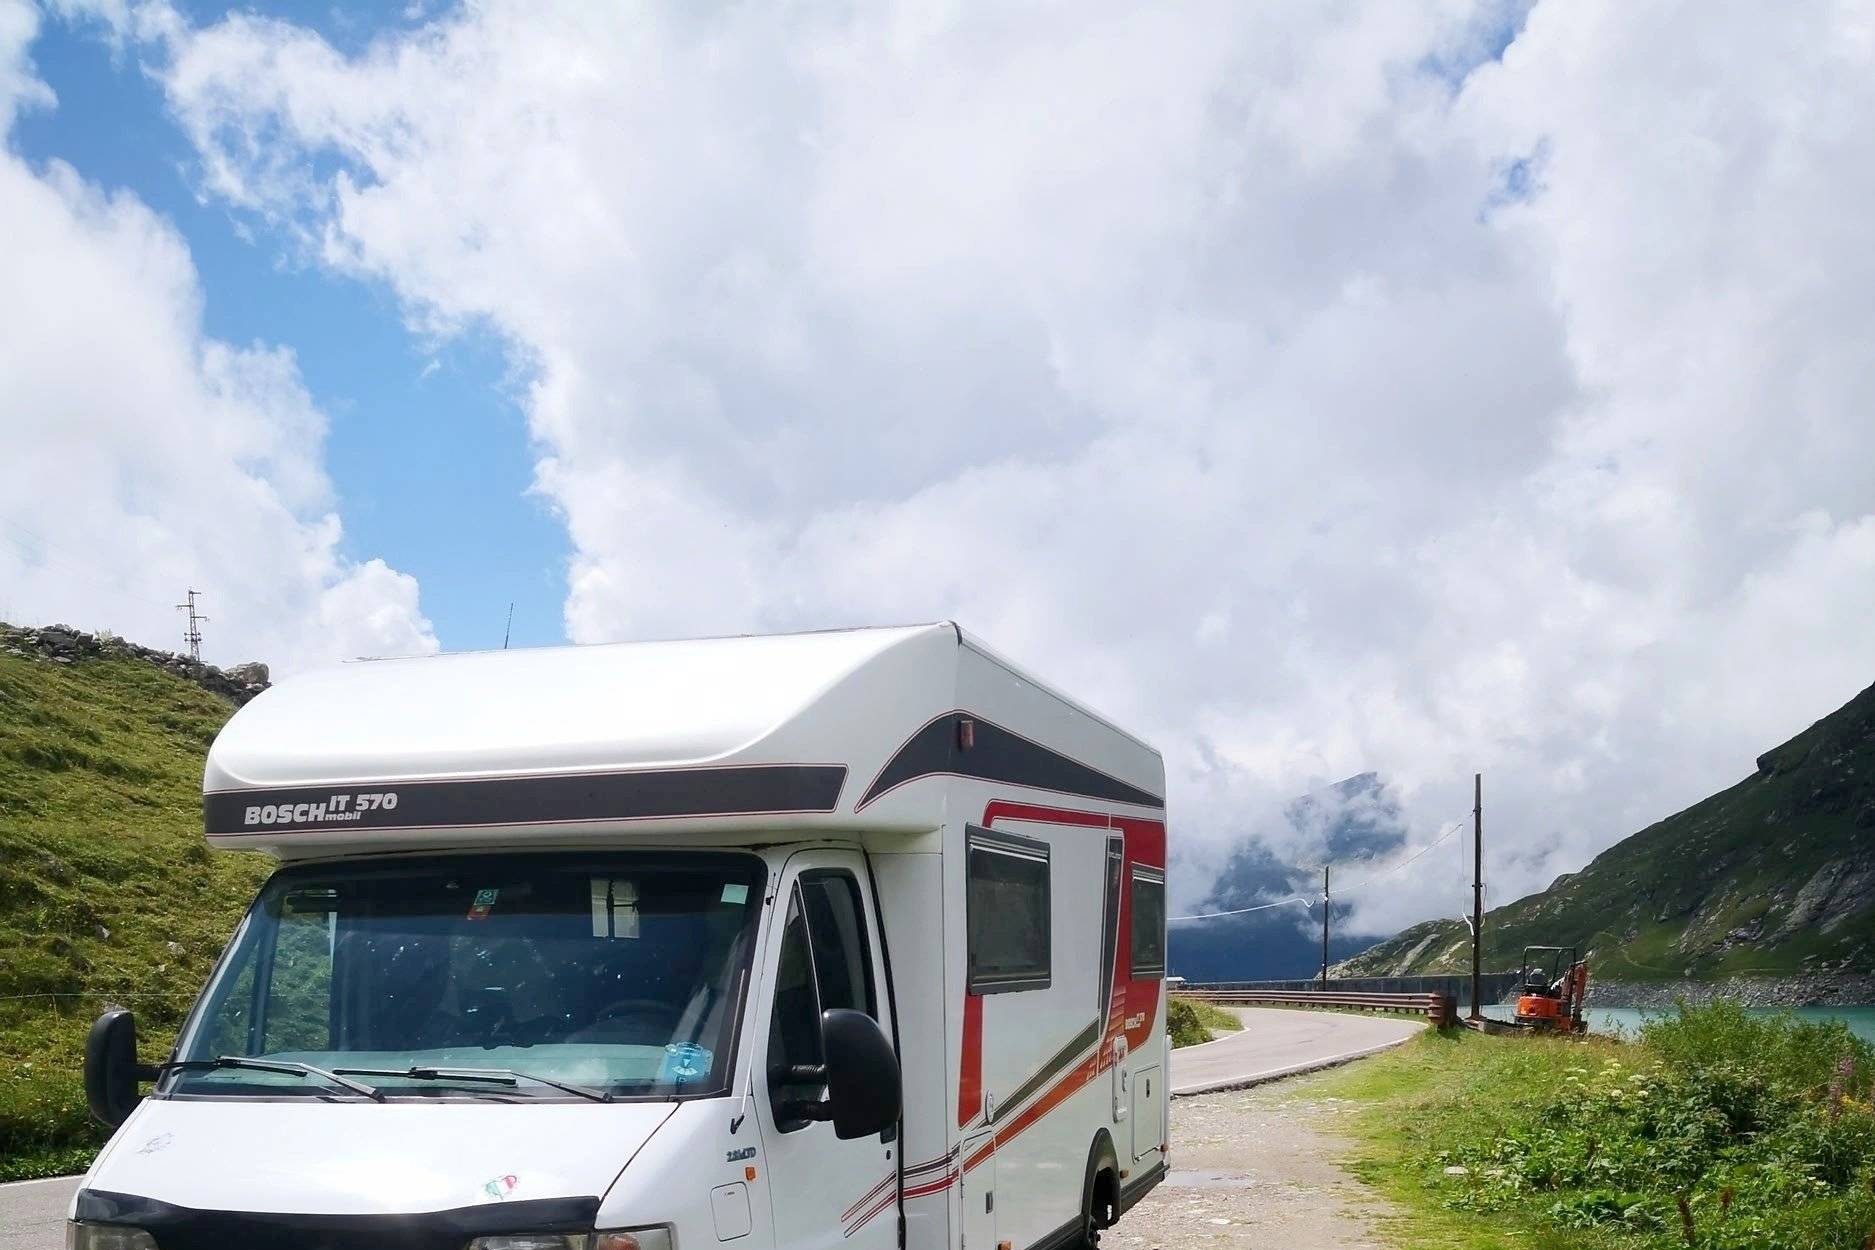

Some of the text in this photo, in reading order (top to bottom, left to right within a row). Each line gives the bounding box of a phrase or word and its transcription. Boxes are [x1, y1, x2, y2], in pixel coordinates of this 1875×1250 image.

[244, 792, 398, 825] BOSCH IT 570
[325, 811, 361, 821] mobil
